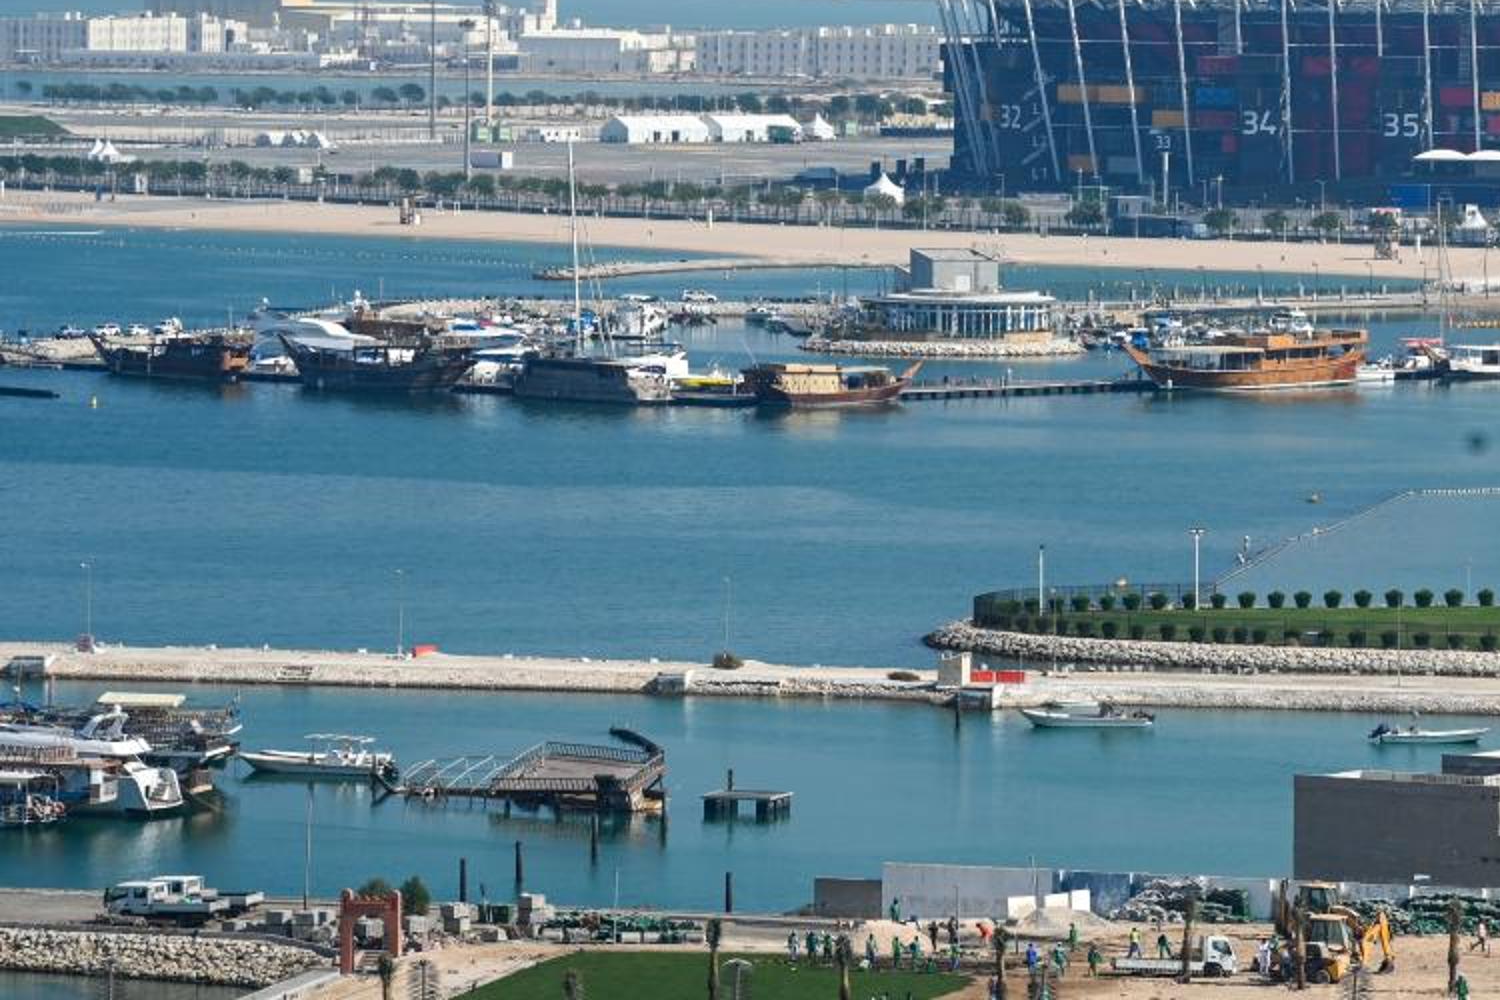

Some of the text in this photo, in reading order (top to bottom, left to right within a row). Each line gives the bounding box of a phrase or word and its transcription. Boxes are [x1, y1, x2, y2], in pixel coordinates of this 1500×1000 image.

[1000, 105, 1021, 128] 32
[1242, 111, 1276, 135] 34
[1384, 113, 1419, 137] 35
[1156, 136, 1171, 149] 33
